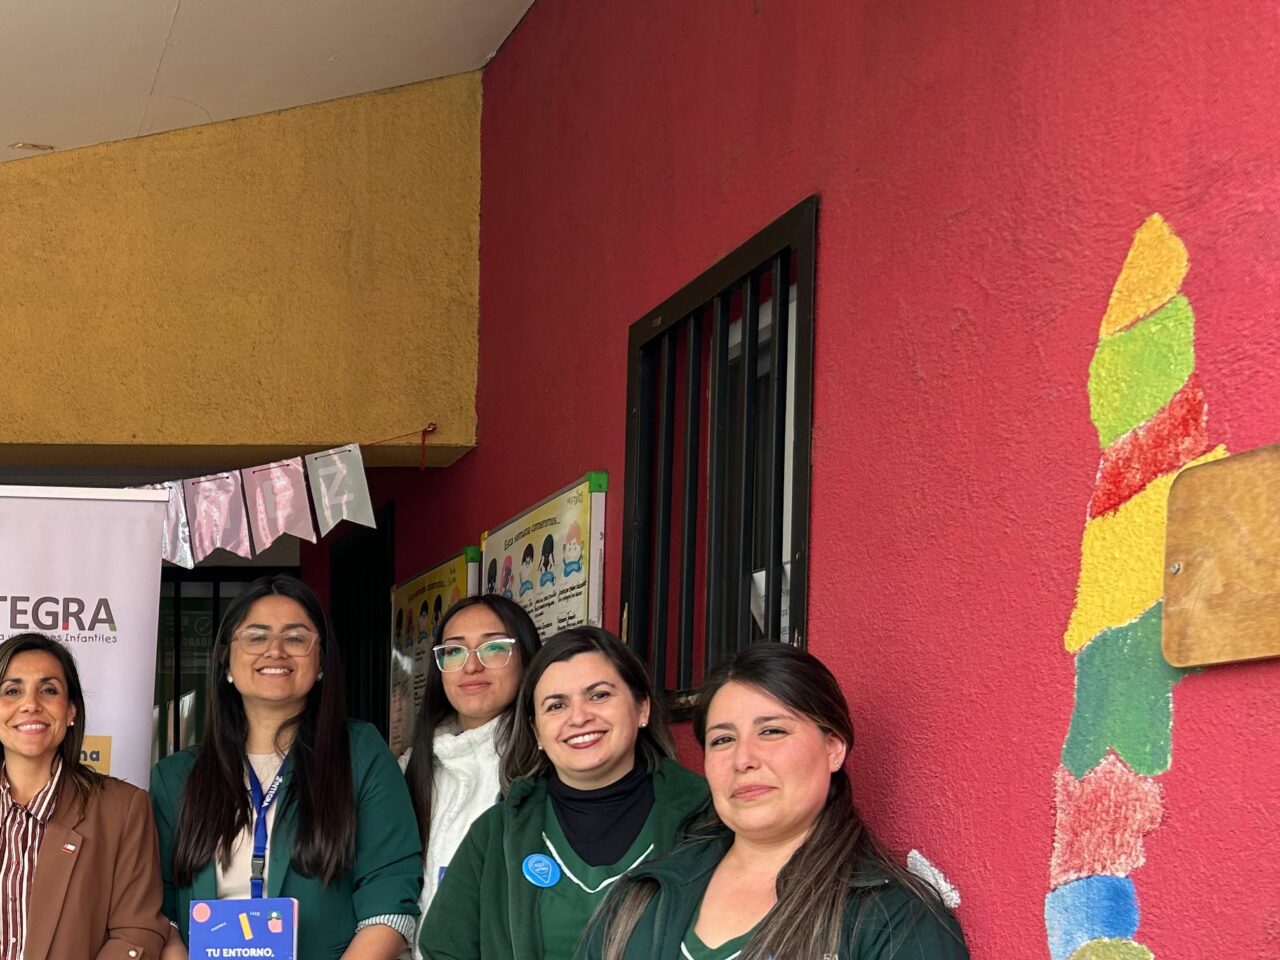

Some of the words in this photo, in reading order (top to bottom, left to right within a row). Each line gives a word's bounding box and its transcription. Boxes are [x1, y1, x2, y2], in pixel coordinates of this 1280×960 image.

[65, 633, 117, 643] Infantiles
[206, 949, 220, 957] TU
[222, 947, 274, 958] ENTORNO,
